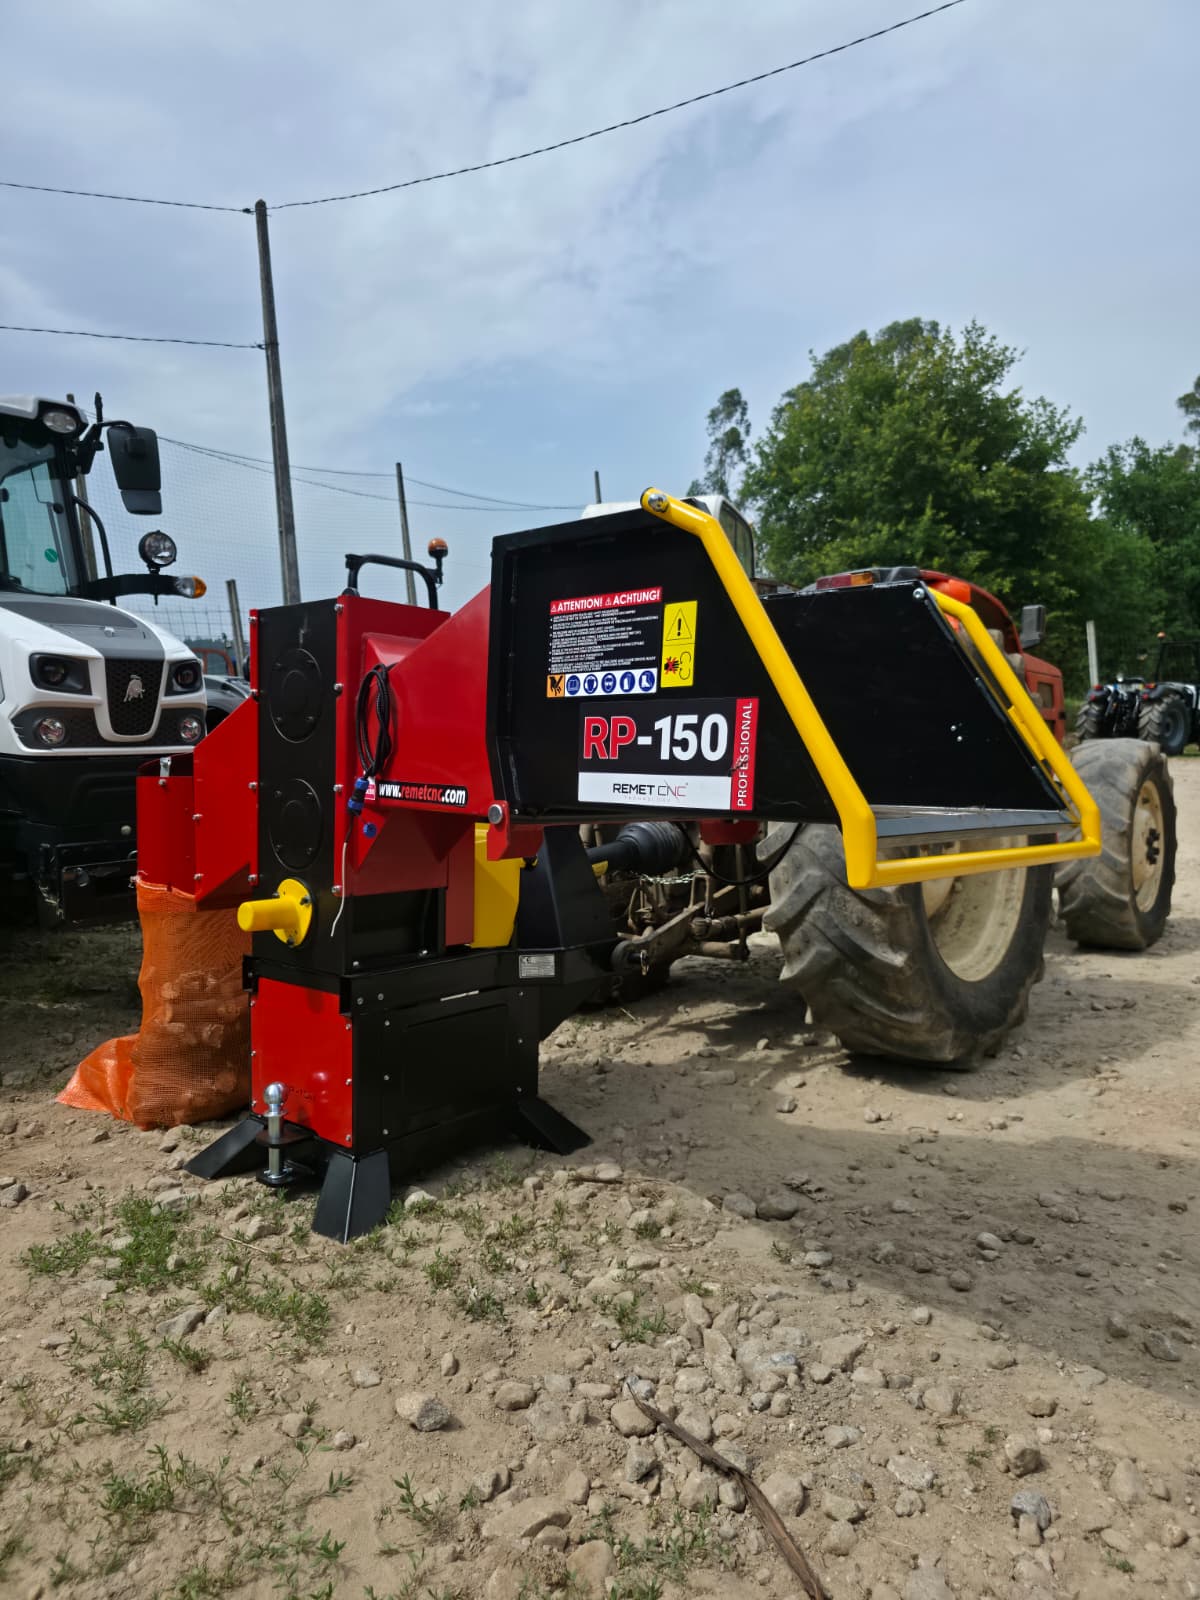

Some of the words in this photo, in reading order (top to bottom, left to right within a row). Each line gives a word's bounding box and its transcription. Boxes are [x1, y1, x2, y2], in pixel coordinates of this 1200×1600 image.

[557, 597, 603, 612] ATTENTION!
[613, 589, 660, 605] ACHTUNG!
[583, 713, 728, 761] RP-150
[737, 702, 753, 807] PROFESSIONAL
[379, 783, 466, 804] www.remetcnc.com
[612, 783, 655, 795] REMET
[657, 782, 687, 798] CNC
